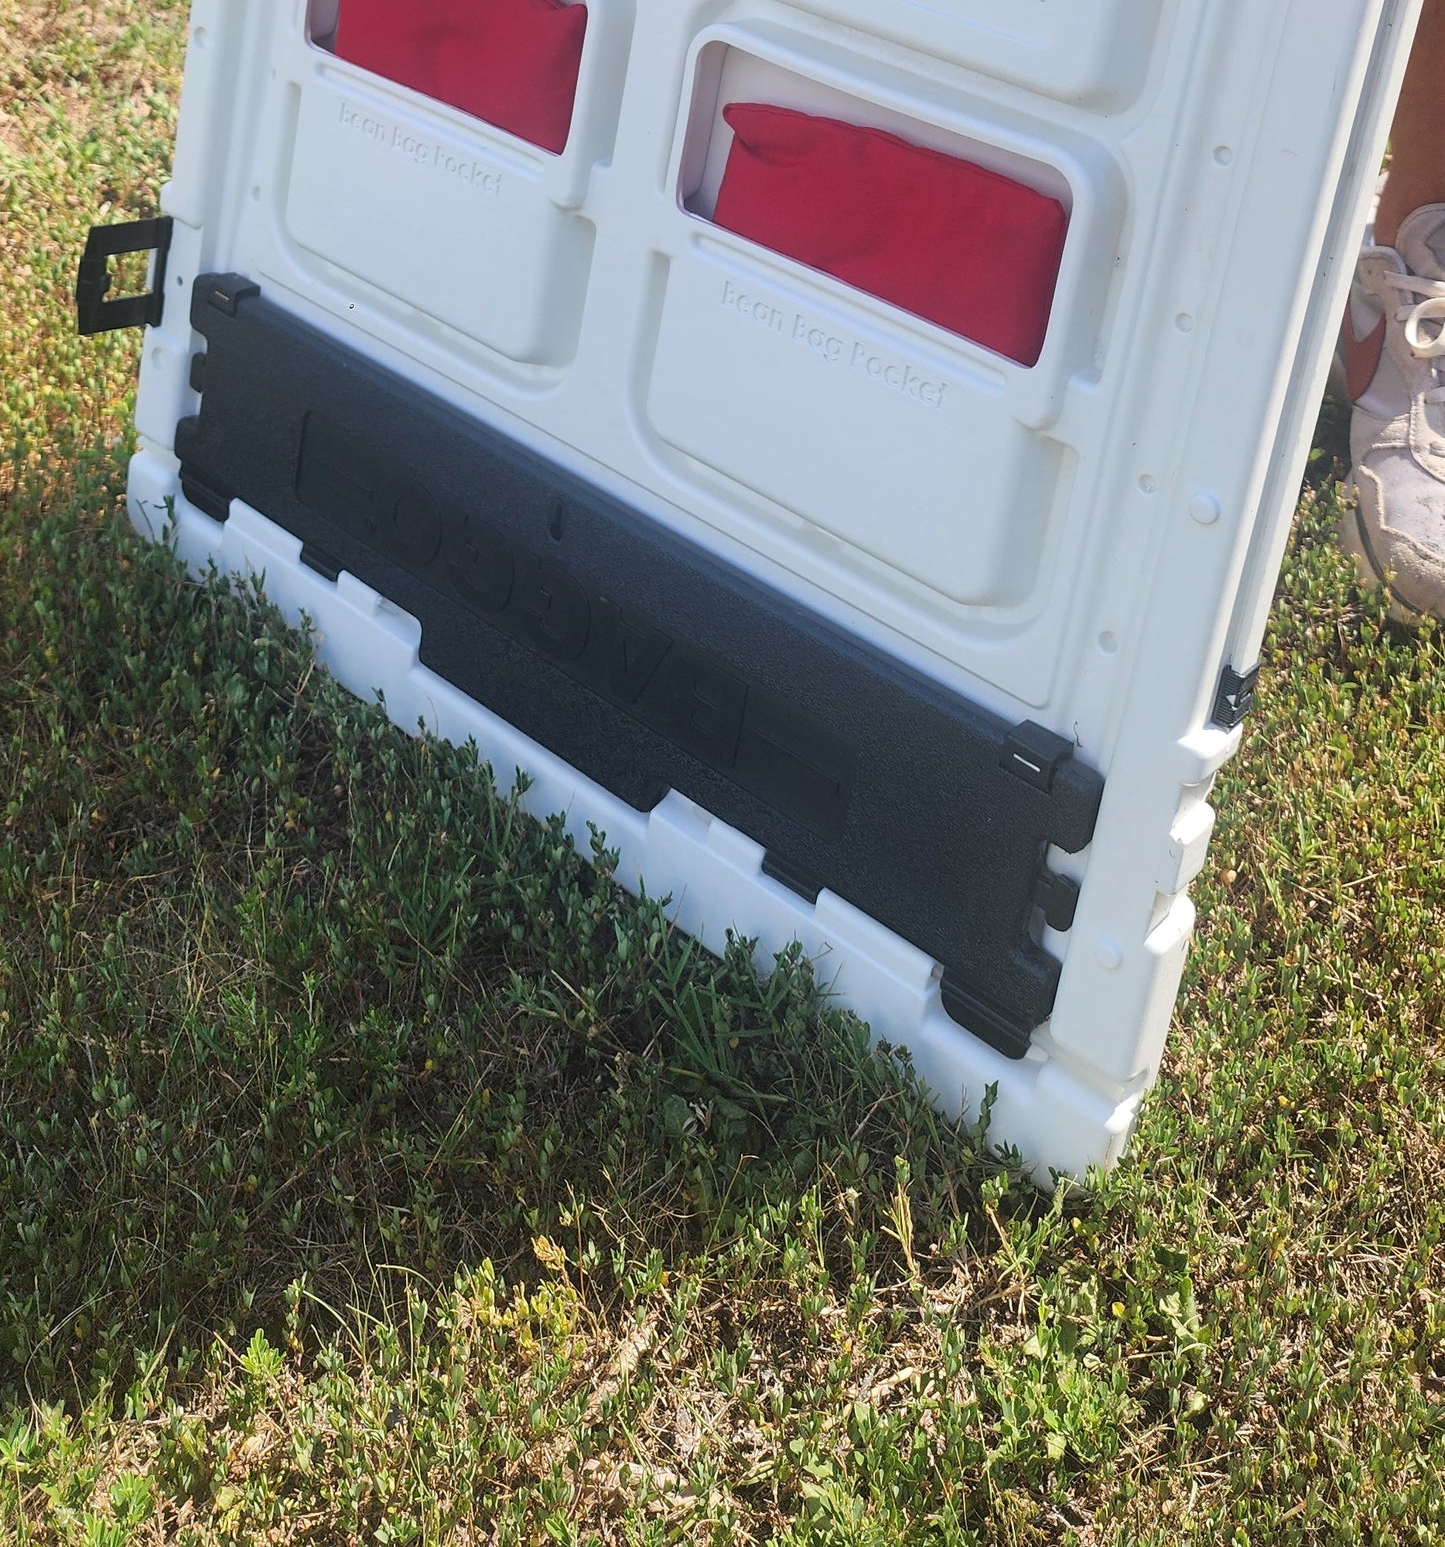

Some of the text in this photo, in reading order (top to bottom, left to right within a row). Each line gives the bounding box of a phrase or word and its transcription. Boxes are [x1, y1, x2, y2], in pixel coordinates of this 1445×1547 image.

[338, 102, 503, 195] Bean Bag Pocket
[720, 280, 949, 410] Bean Bag Pocket
